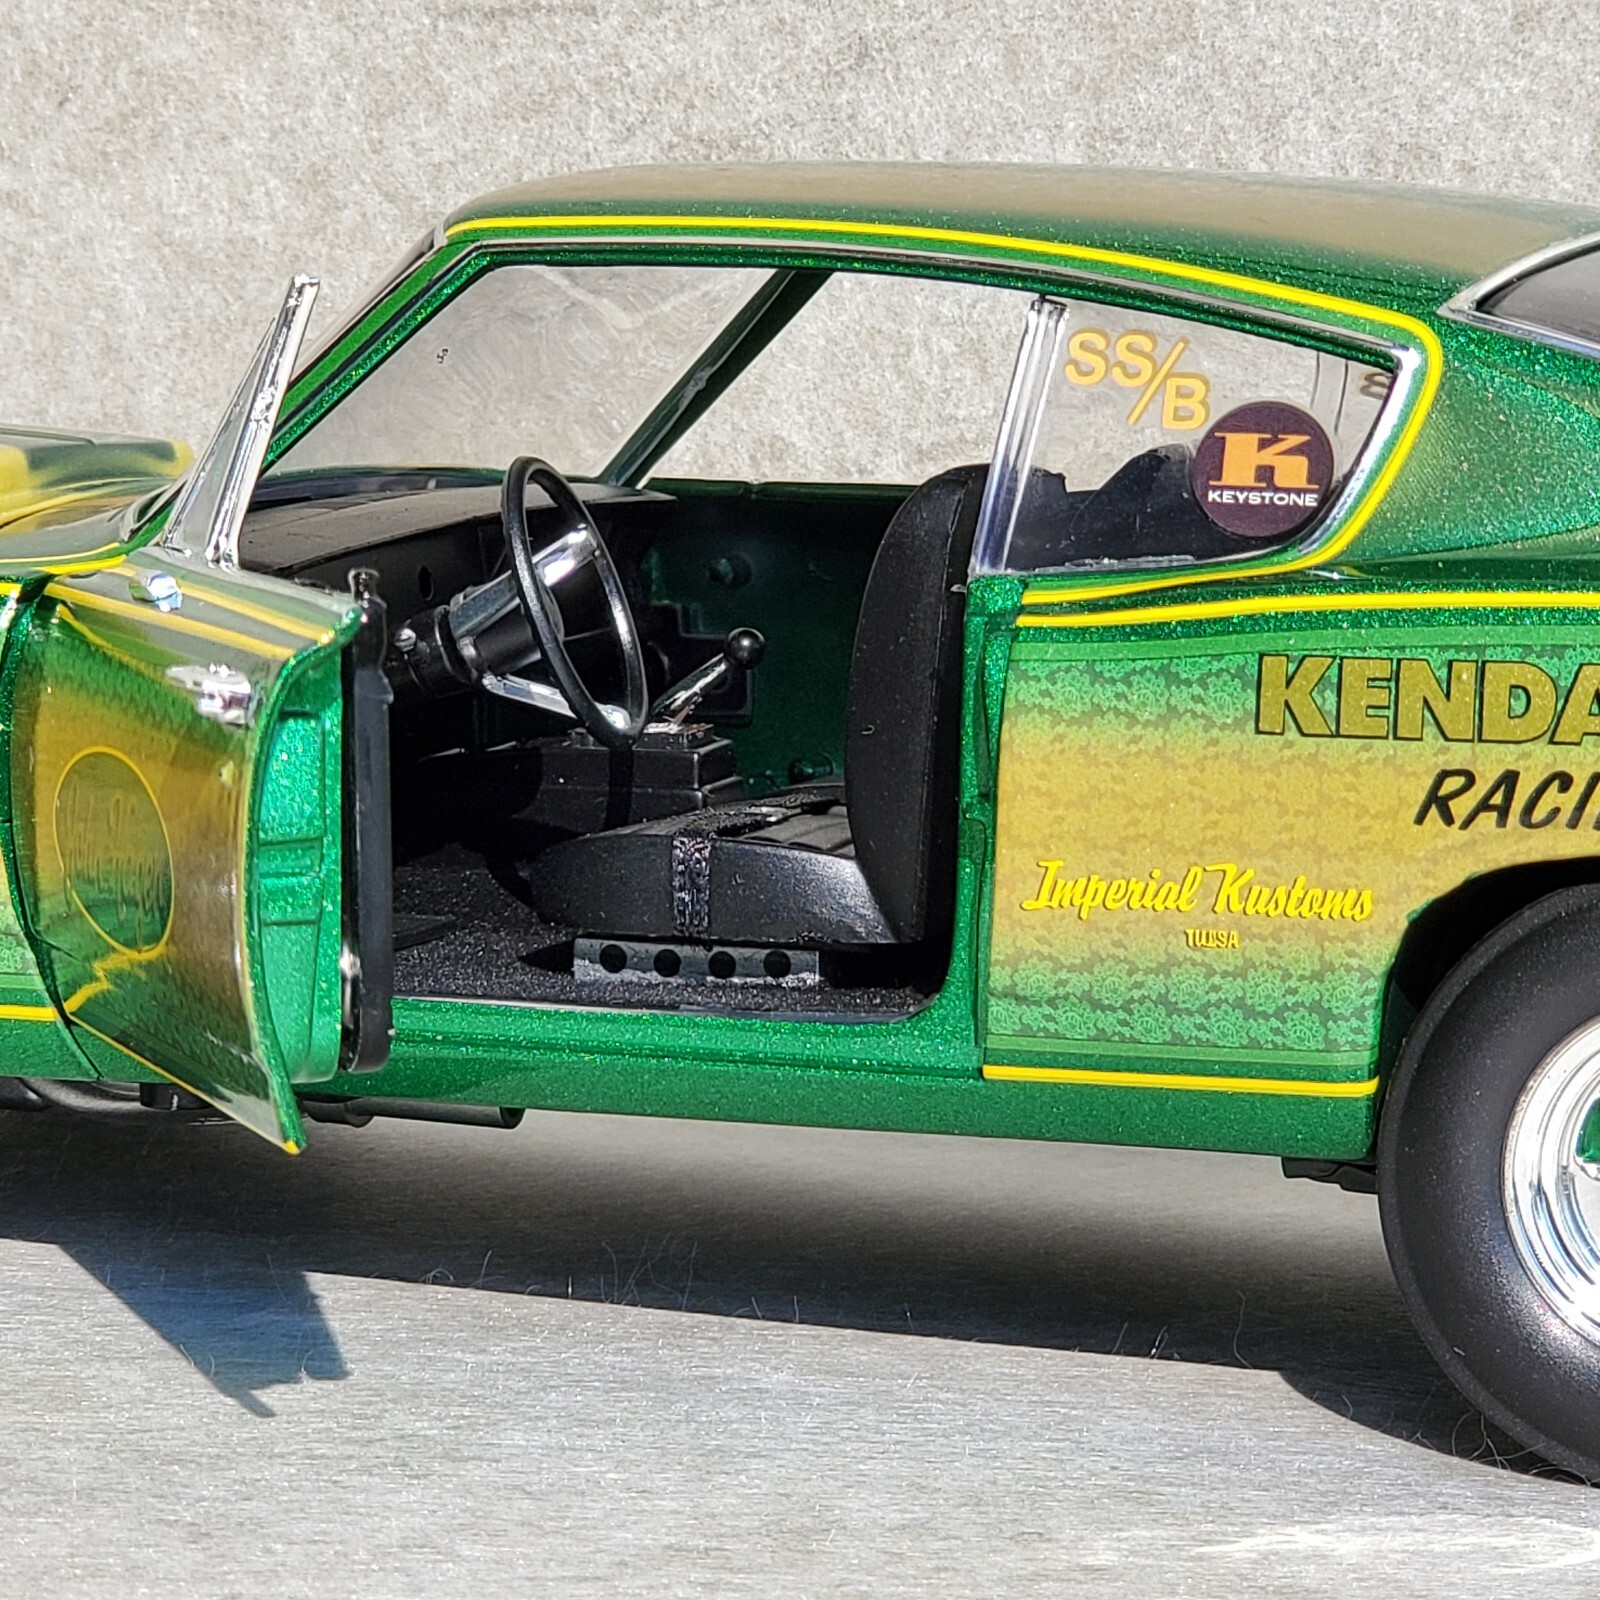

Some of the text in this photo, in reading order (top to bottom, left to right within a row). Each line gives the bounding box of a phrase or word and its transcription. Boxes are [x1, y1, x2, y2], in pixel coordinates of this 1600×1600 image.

[1064, 329, 1209, 430] SS/B
[1208, 431, 1320, 489] K
[1207, 489, 1319, 507] KEYSTONE
[1413, 767, 1600, 831] RACI
[1019, 859, 1374, 922] Imperial Kustoms
